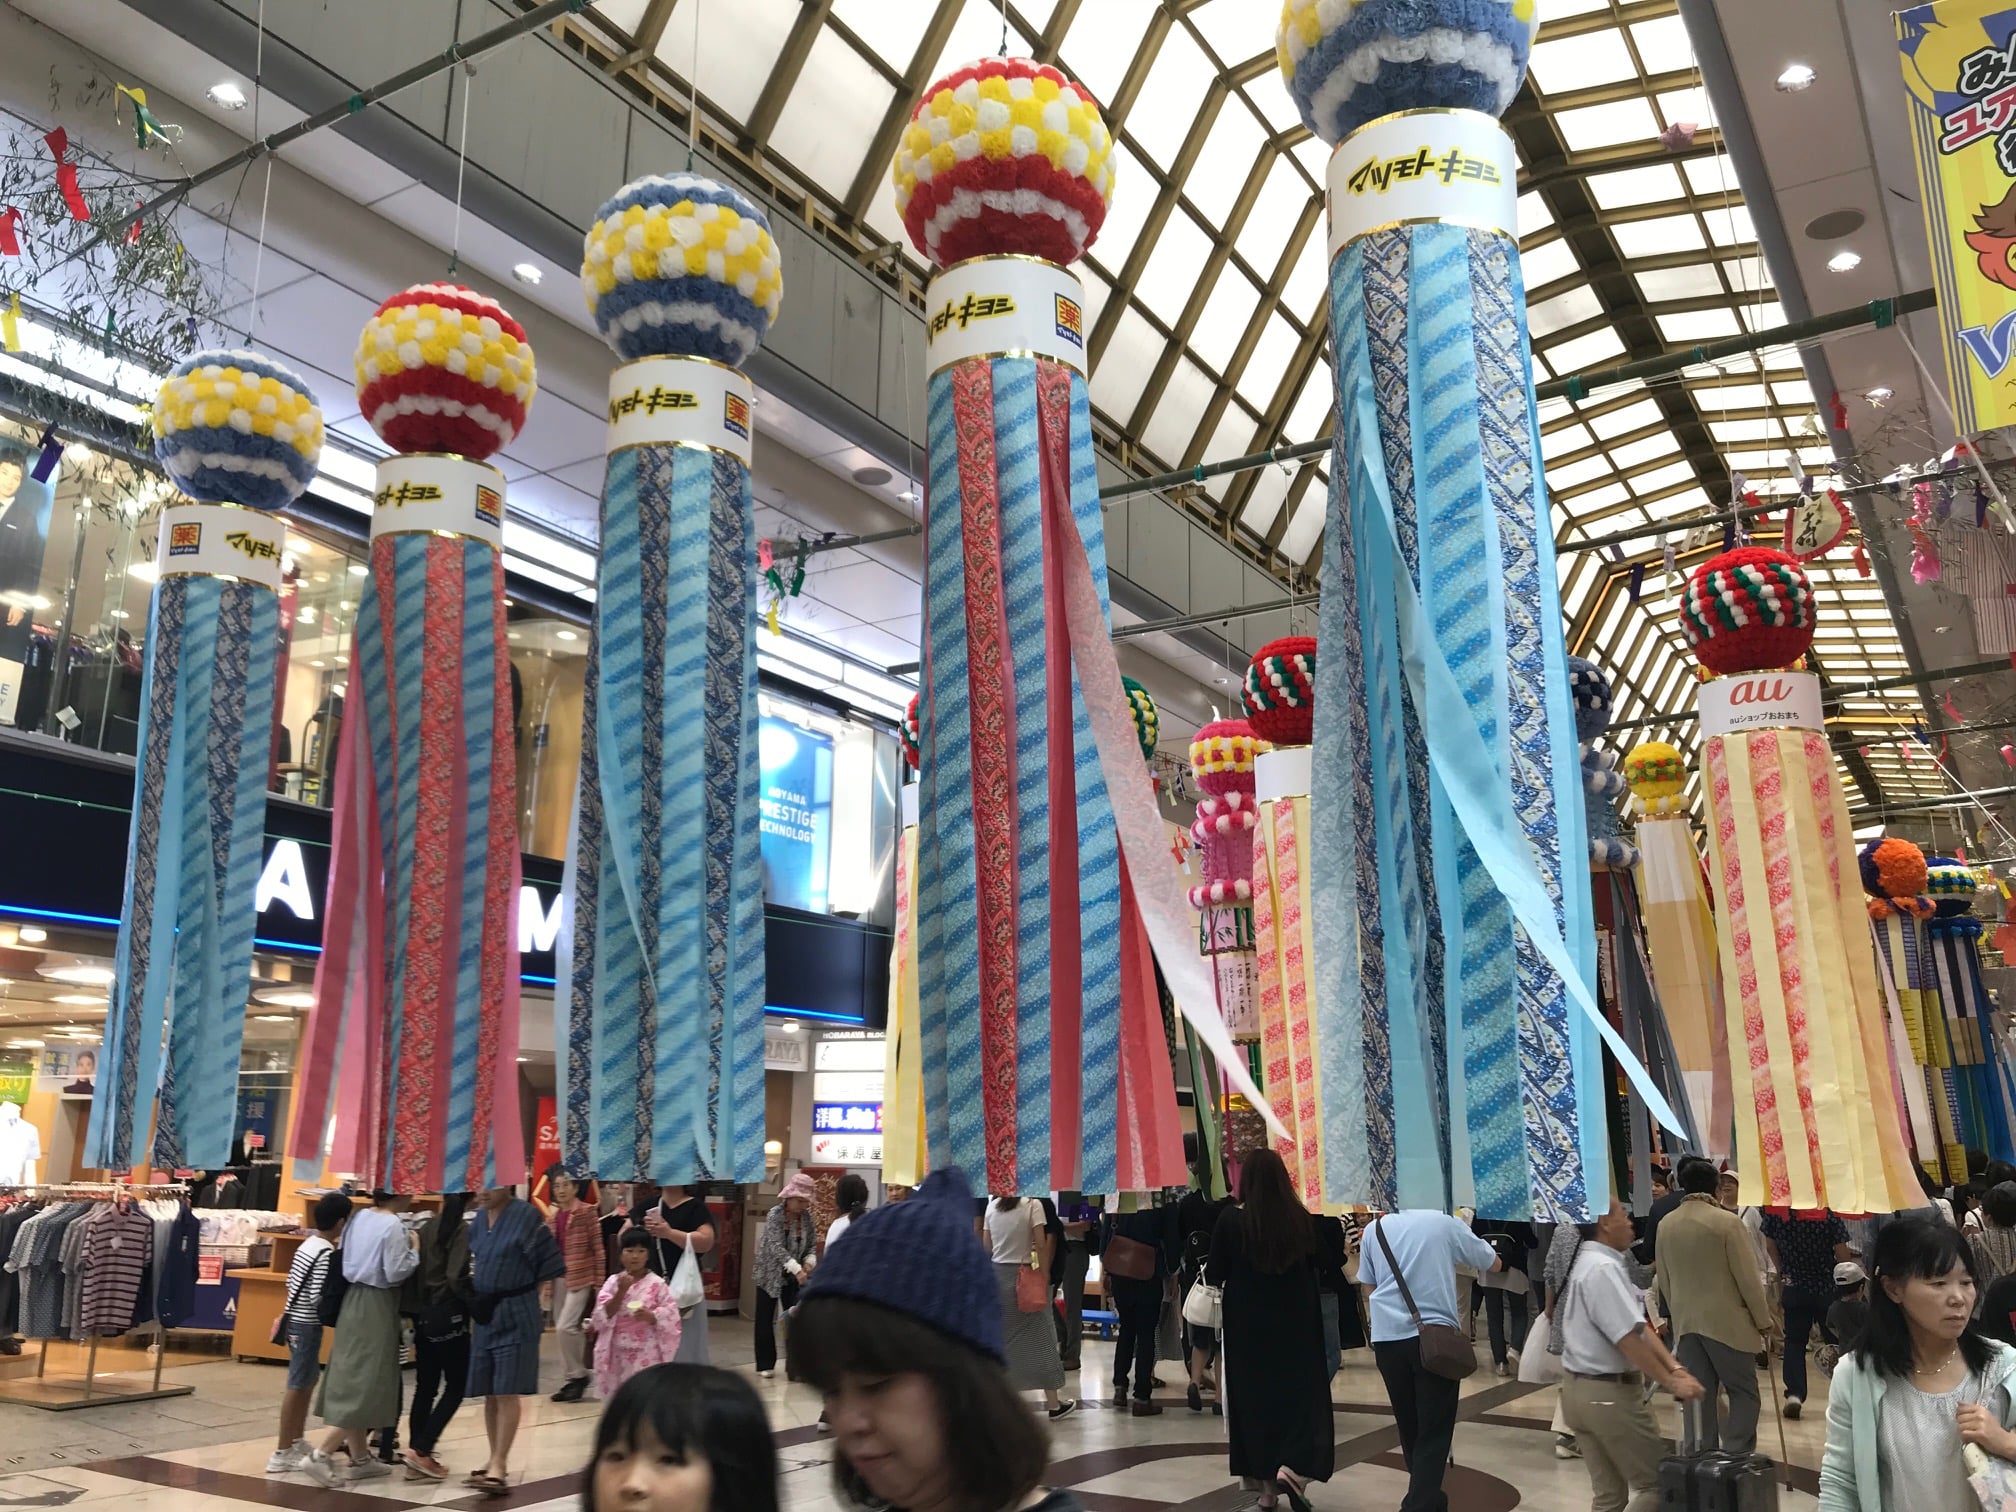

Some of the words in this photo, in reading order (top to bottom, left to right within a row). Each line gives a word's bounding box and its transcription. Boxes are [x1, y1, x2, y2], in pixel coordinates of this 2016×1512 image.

[1961, 32, 2016, 94] み
[1349, 149, 1500, 192] マツモトキヨシ
[1058, 299, 1080, 333] 薬
[1957, 308, 2016, 380] V
[1730, 679, 1793, 705] au
[1730, 711, 1800, 725] auショップおおまち
[254, 839, 315, 920] A
[517, 886, 564, 953] M
